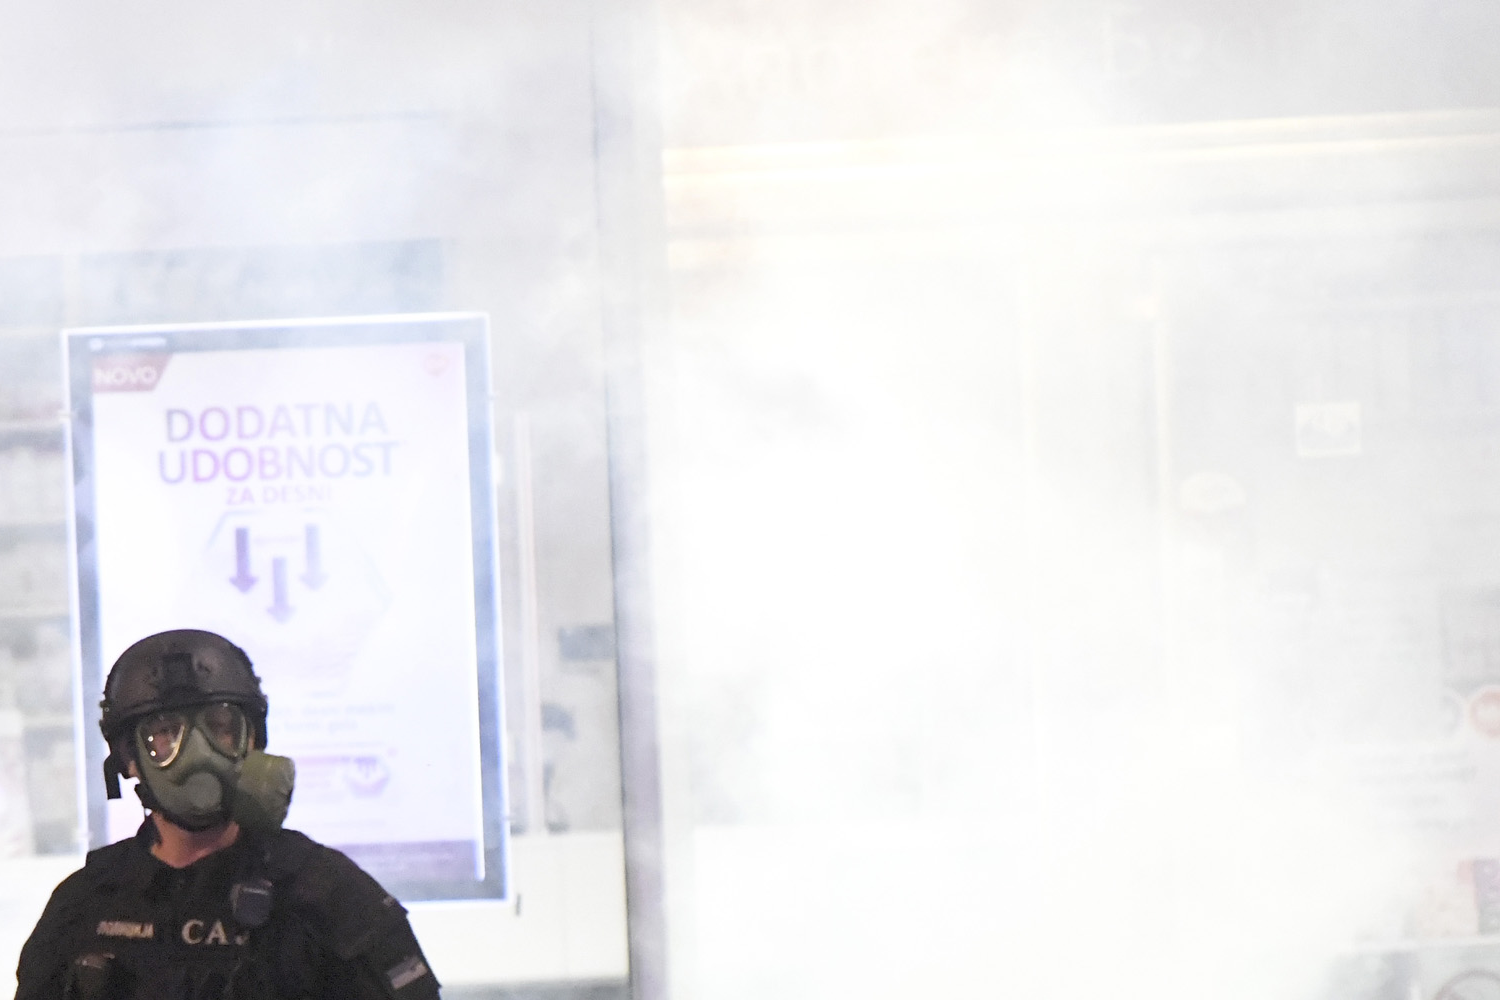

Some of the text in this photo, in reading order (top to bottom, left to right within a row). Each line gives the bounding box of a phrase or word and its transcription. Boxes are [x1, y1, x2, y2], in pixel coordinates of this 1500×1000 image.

[93, 364, 158, 387] NOVO
[167, 402, 388, 441] DODATNA
[159, 441, 395, 483] UDOBNOST
[225, 483, 334, 506] ZA DESNI
